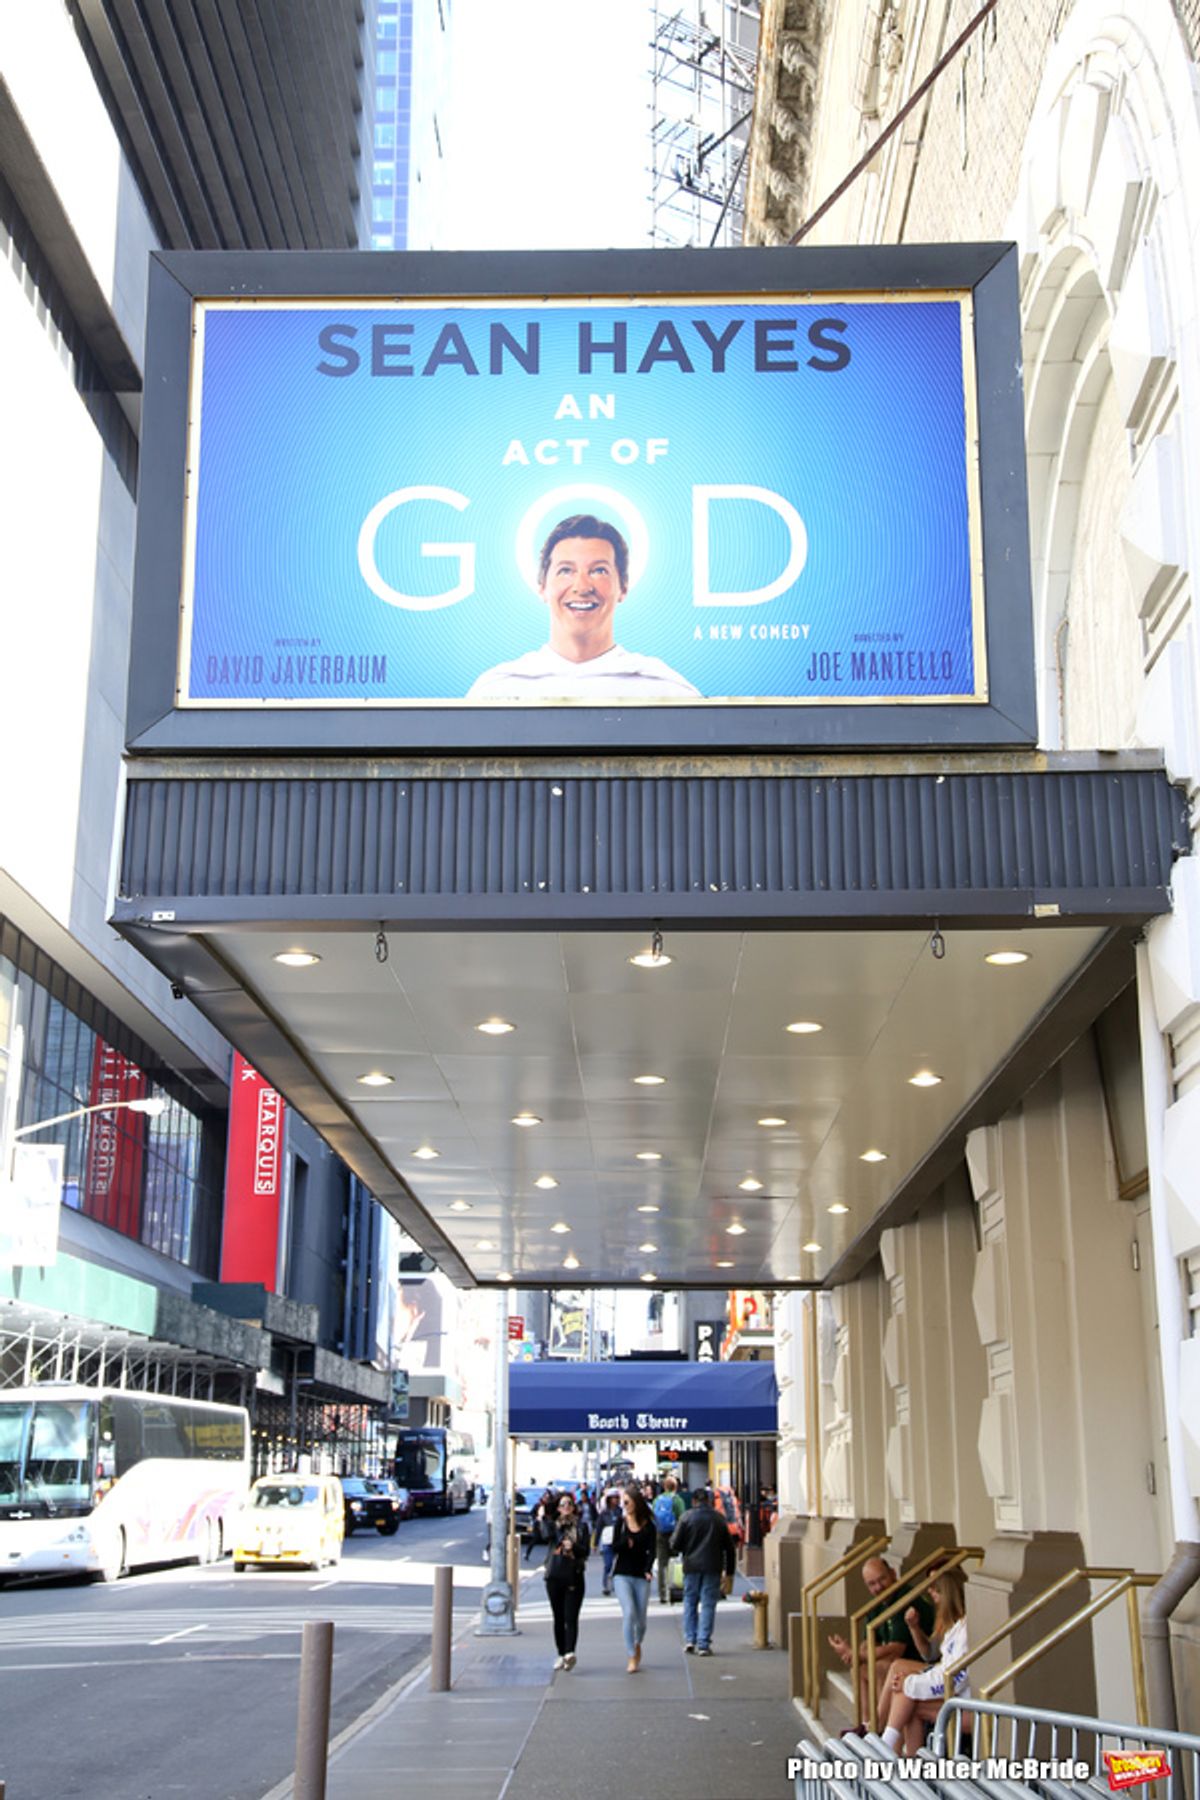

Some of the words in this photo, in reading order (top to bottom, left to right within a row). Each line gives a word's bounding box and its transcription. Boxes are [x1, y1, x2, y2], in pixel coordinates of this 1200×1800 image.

[316, 322, 540, 377] SEAN
[578, 318, 852, 374] HAYES
[554, 393, 616, 420] AN
[501, 438, 591, 465] ACT
[610, 438, 670, 465] OF
[357, 483, 809, 612] GOD
[693, 624, 703, 640] A
[709, 624, 744, 640] NEW
[750, 624, 811, 640] COMEDY
[206, 655, 264, 685] DAVID
[271, 654, 387, 685] JAVERBAUM
[807, 651, 843, 681] JOE
[851, 650, 952, 681] MANTELLO
[257, 1090, 277, 1191] MARQUIS
[588, 1413, 630, 1430] Booth
[636, 1413, 689, 1430] Theatre
[660, 1439, 708, 1451] PARK
